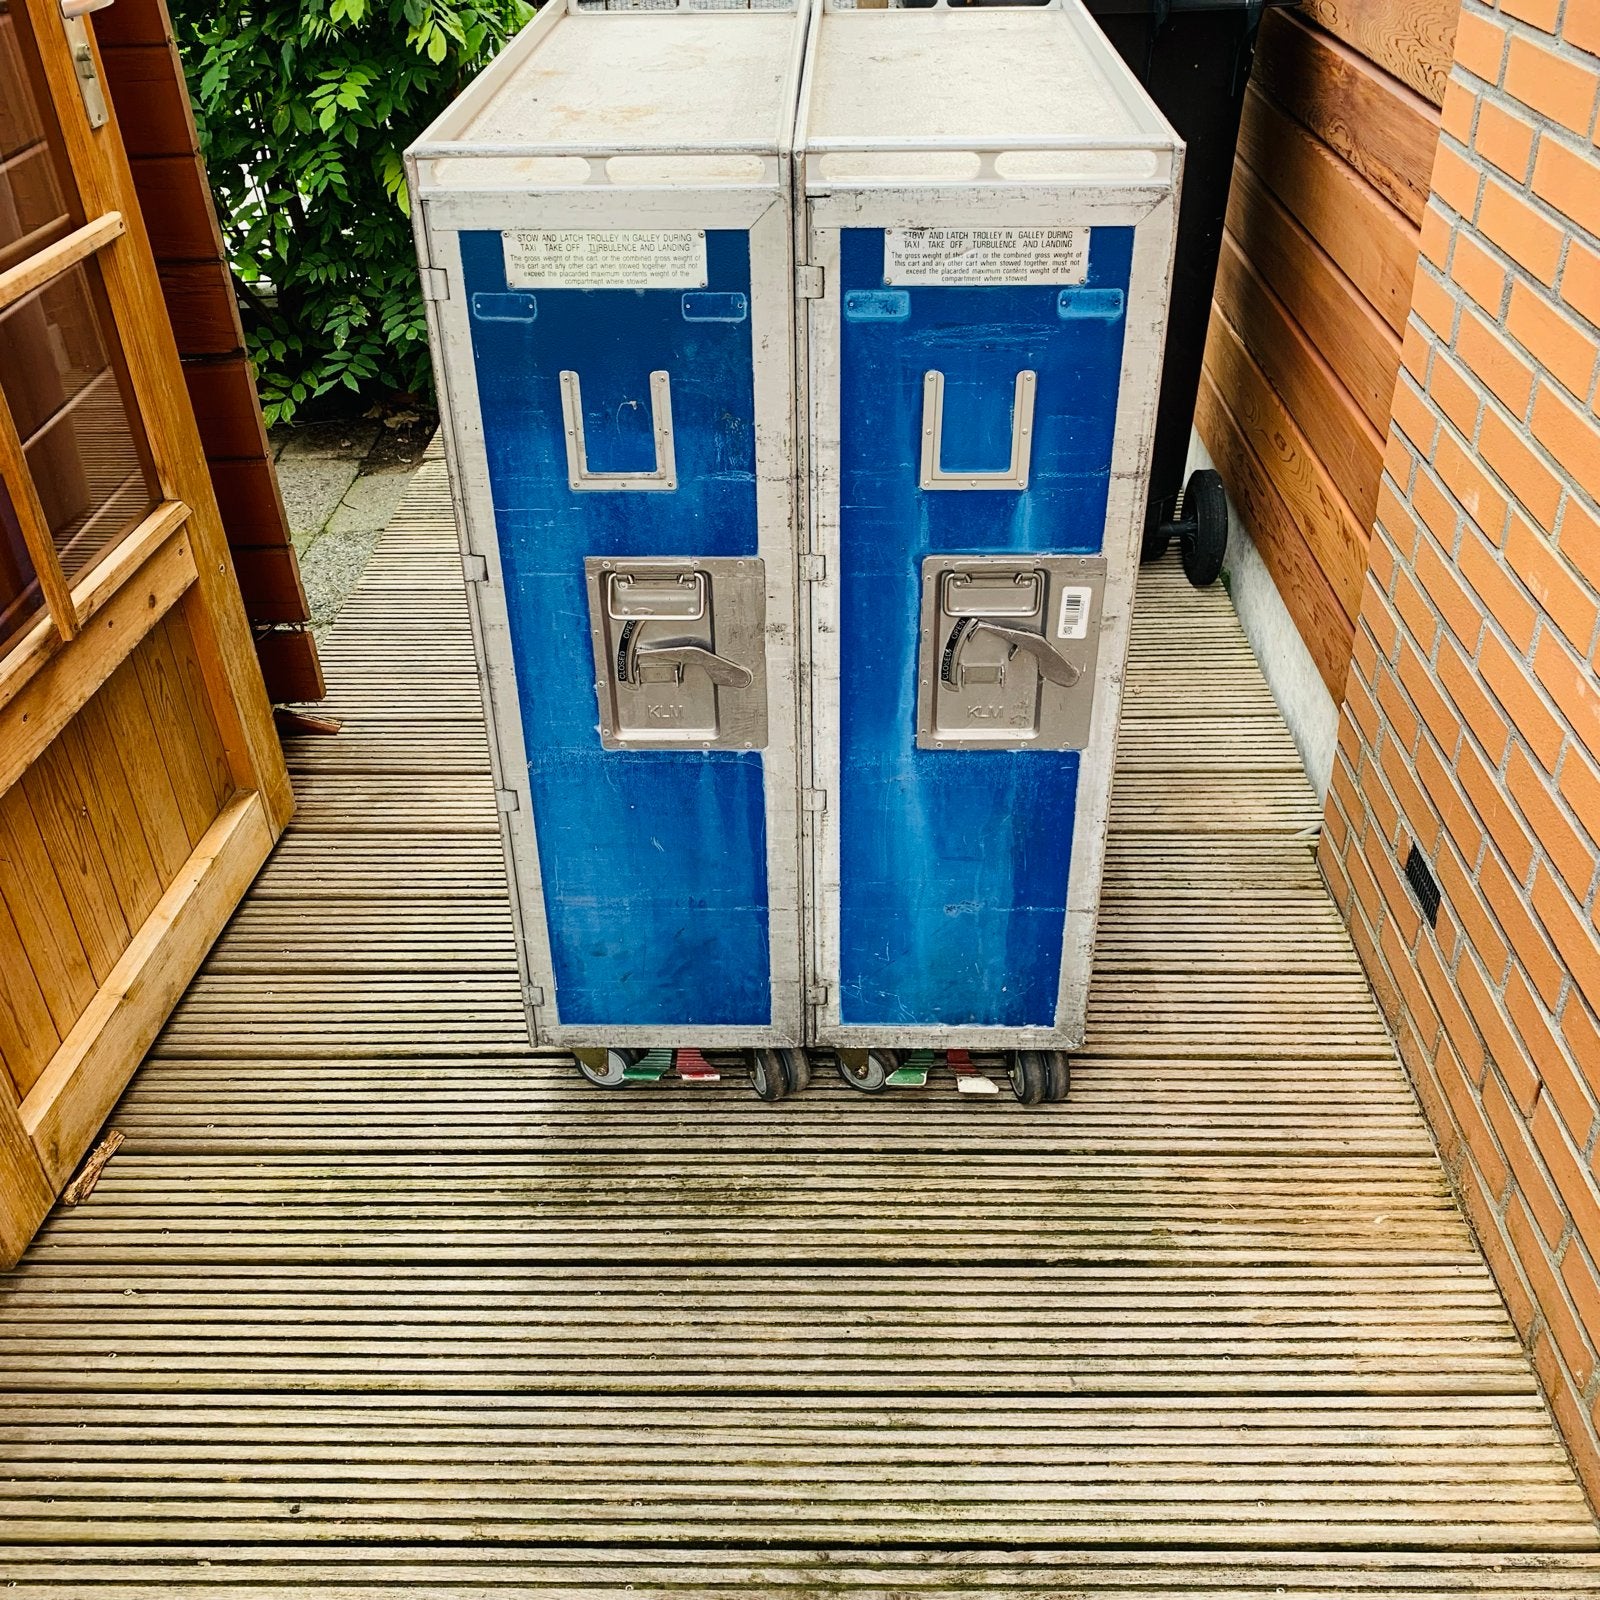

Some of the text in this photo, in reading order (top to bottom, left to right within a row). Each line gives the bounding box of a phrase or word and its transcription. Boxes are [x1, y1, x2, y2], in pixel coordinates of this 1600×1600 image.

[517, 234, 691, 242] STOW AND LATCH TROLLEY IN GALLEY DURING
[973, 231, 1002, 239] TROLLEY
[1006, 231, 1012, 239] IN
[1018, 231, 1044, 239] GALLEY
[588, 244, 636, 252] TURBULENCE
[1042, 240, 1072, 248] LANDING
[543, 255, 562, 263] weight
[673, 255, 693, 263] weight
[922, 252, 942, 260] weight
[623, 620, 636, 639] OPEN
[952, 620, 967, 640] OPEN
[942, 648, 952, 680] CLOSED
[647, 705, 684, 719] KLM
[967, 705, 1004, 719] KLM
